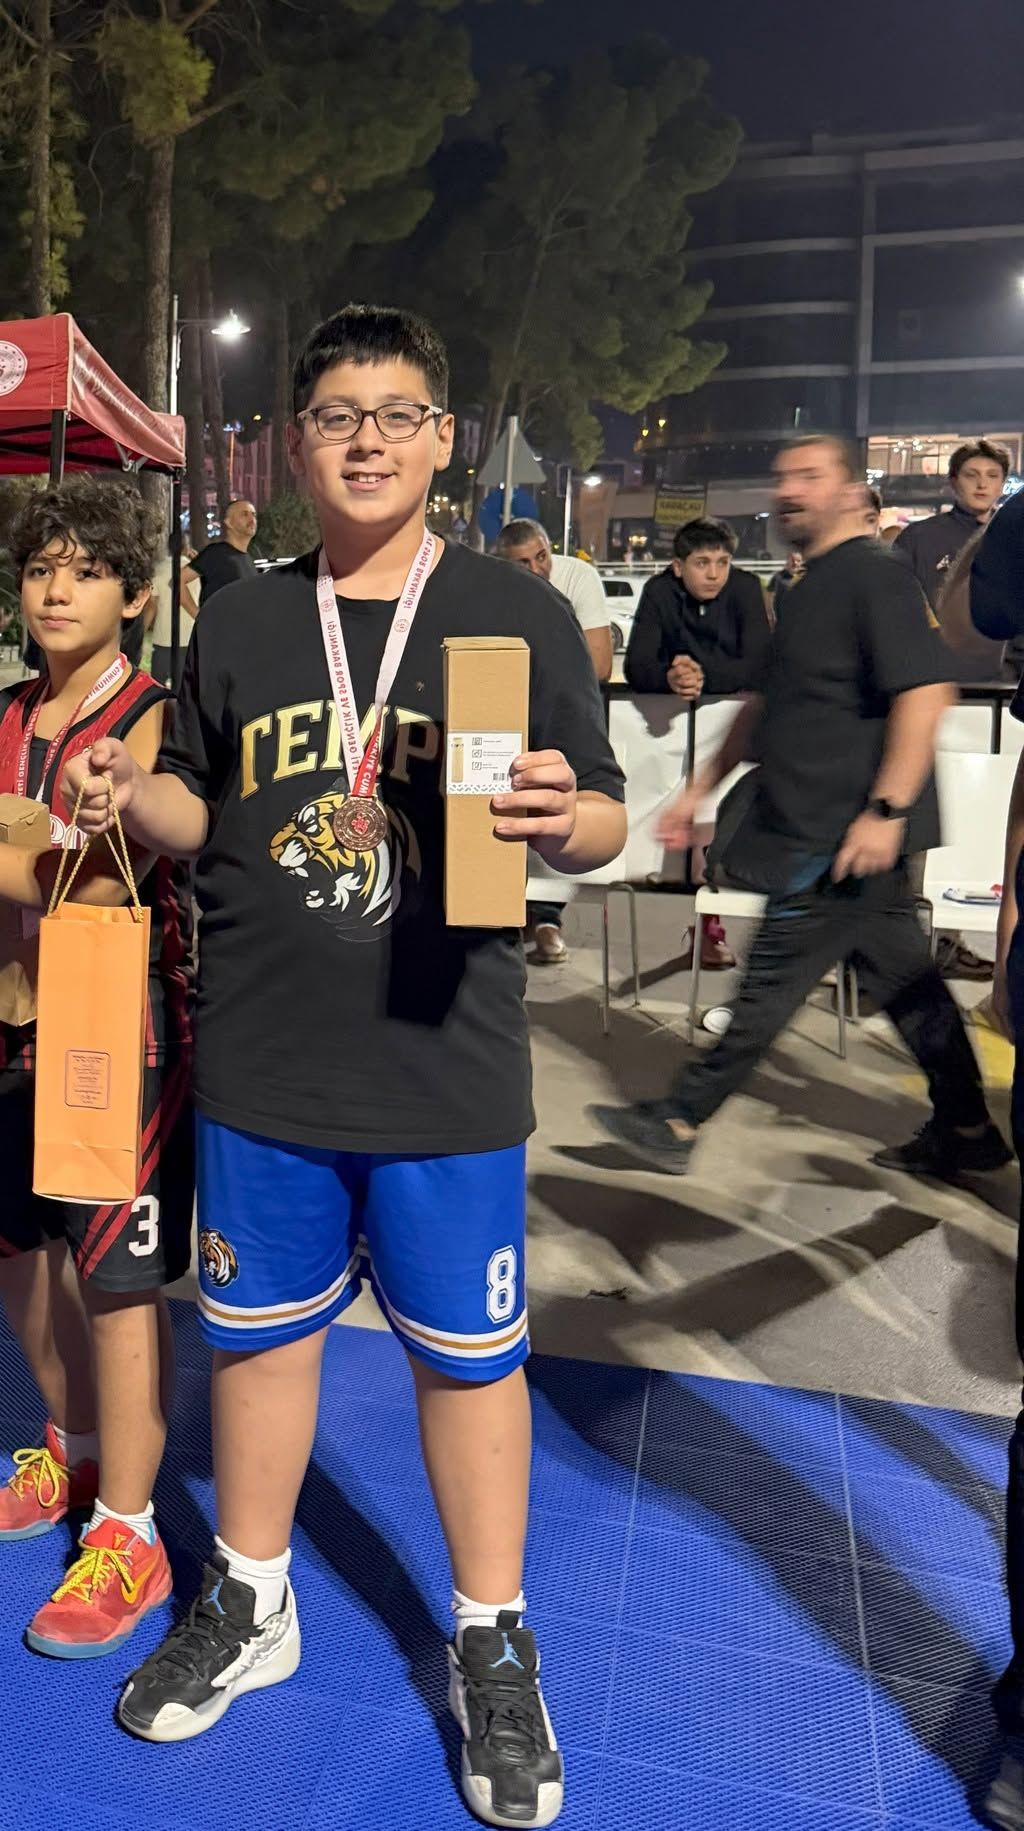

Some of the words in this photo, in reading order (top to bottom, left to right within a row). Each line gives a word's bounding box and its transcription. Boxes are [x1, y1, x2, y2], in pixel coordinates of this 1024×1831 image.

[240, 699, 442, 801] TEMP
[128, 1194, 160, 1257] 3
[486, 1244, 518, 1324] 8
